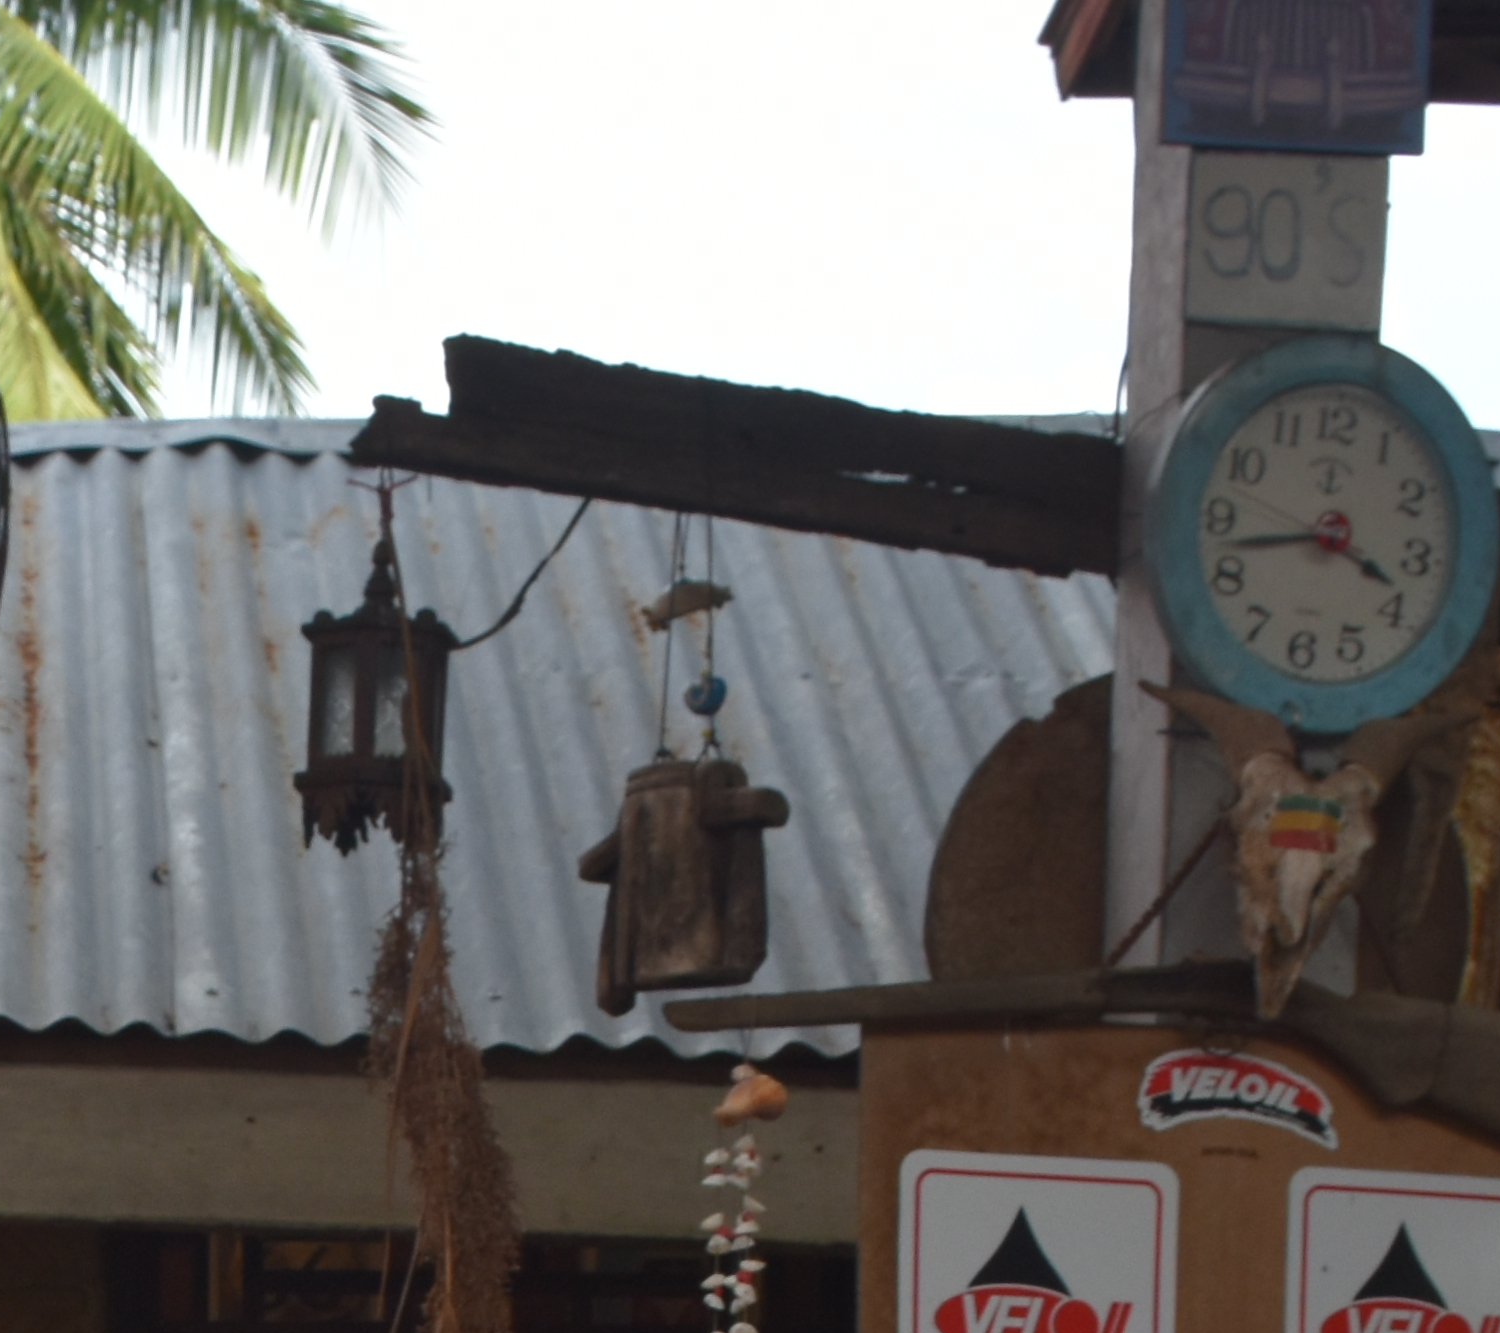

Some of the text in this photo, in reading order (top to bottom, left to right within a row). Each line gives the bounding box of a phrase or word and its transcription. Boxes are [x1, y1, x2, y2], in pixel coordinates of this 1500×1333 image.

[1272, 411, 1301, 447] 11
[1317, 405, 1359, 447] 12
[1229, 447, 1266, 485] 10
[1377, 432, 1390, 465] 1
[1205, 497, 1236, 535] 9
[1397, 478, 1425, 518] 2
[1212, 555, 1245, 596] 8
[1400, 538, 1433, 577] 3
[1245, 604, 1272, 642] 7
[1376, 591, 1404, 628] 4
[1287, 630, 1317, 669] 6
[1337, 625, 1365, 663] 5
[1170, 1066, 1301, 1114] VELOIL
